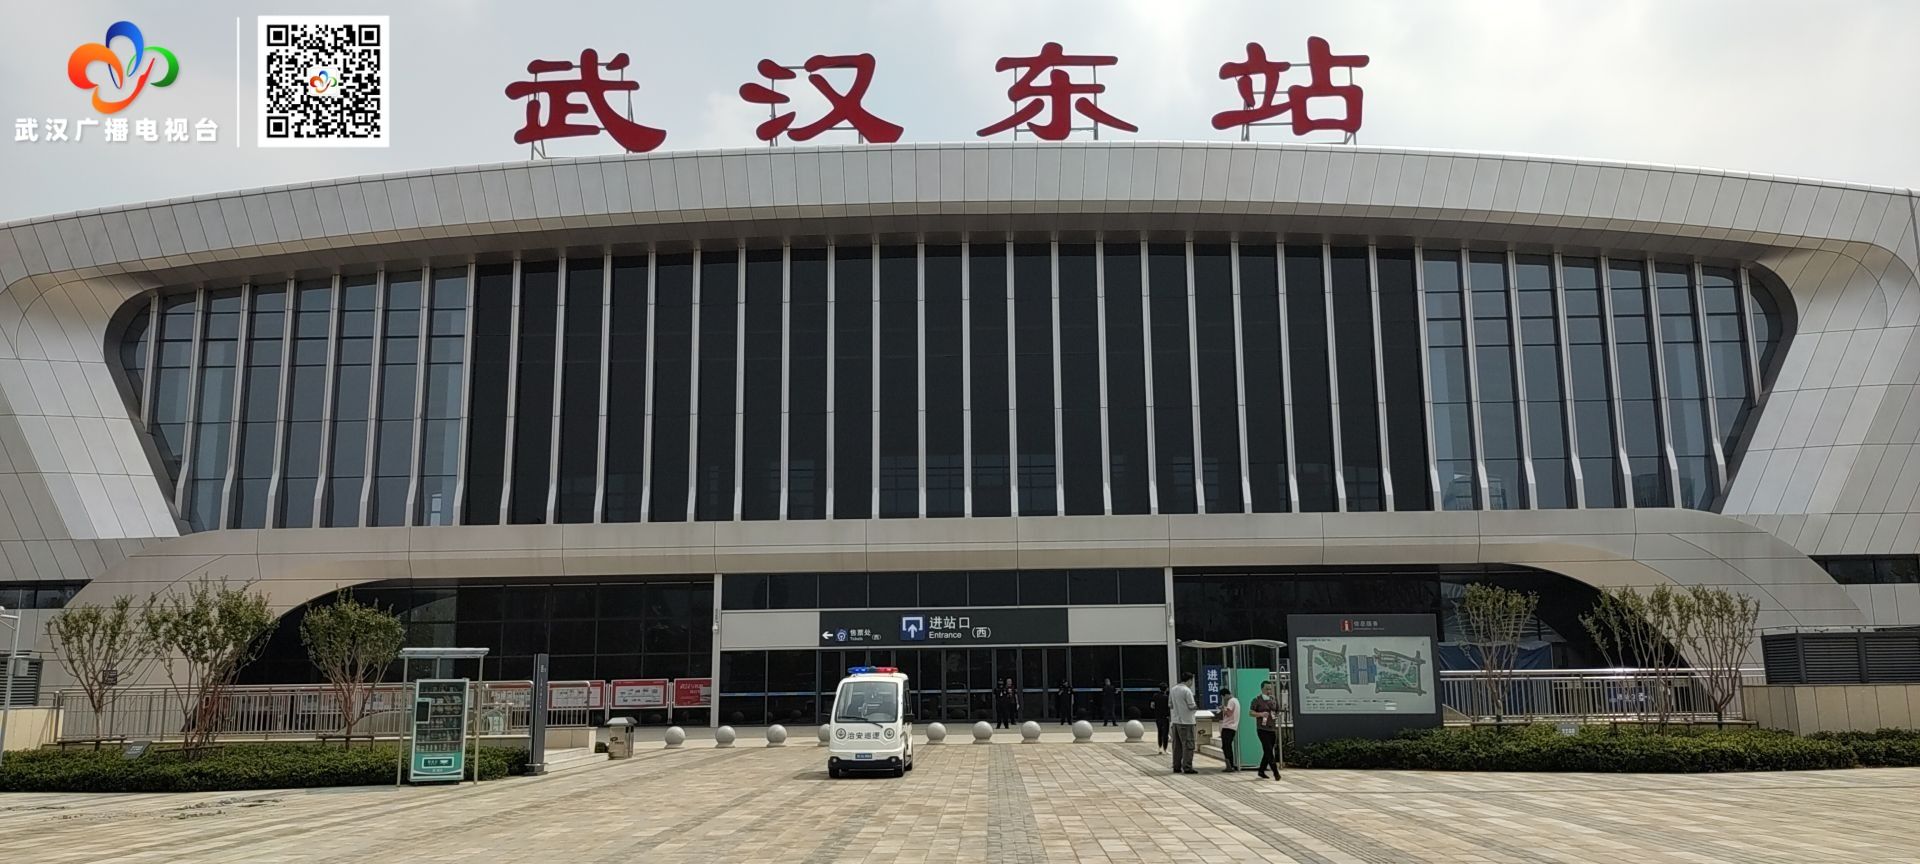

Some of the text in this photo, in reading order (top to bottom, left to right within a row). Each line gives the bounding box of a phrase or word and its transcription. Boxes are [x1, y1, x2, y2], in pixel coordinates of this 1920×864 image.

[505, 36, 1369, 152] 武汉东站
[929, 616, 970, 630] 进站口
[929, 631, 962, 639] Entrance
[1207, 669, 1219, 704] 进站口
